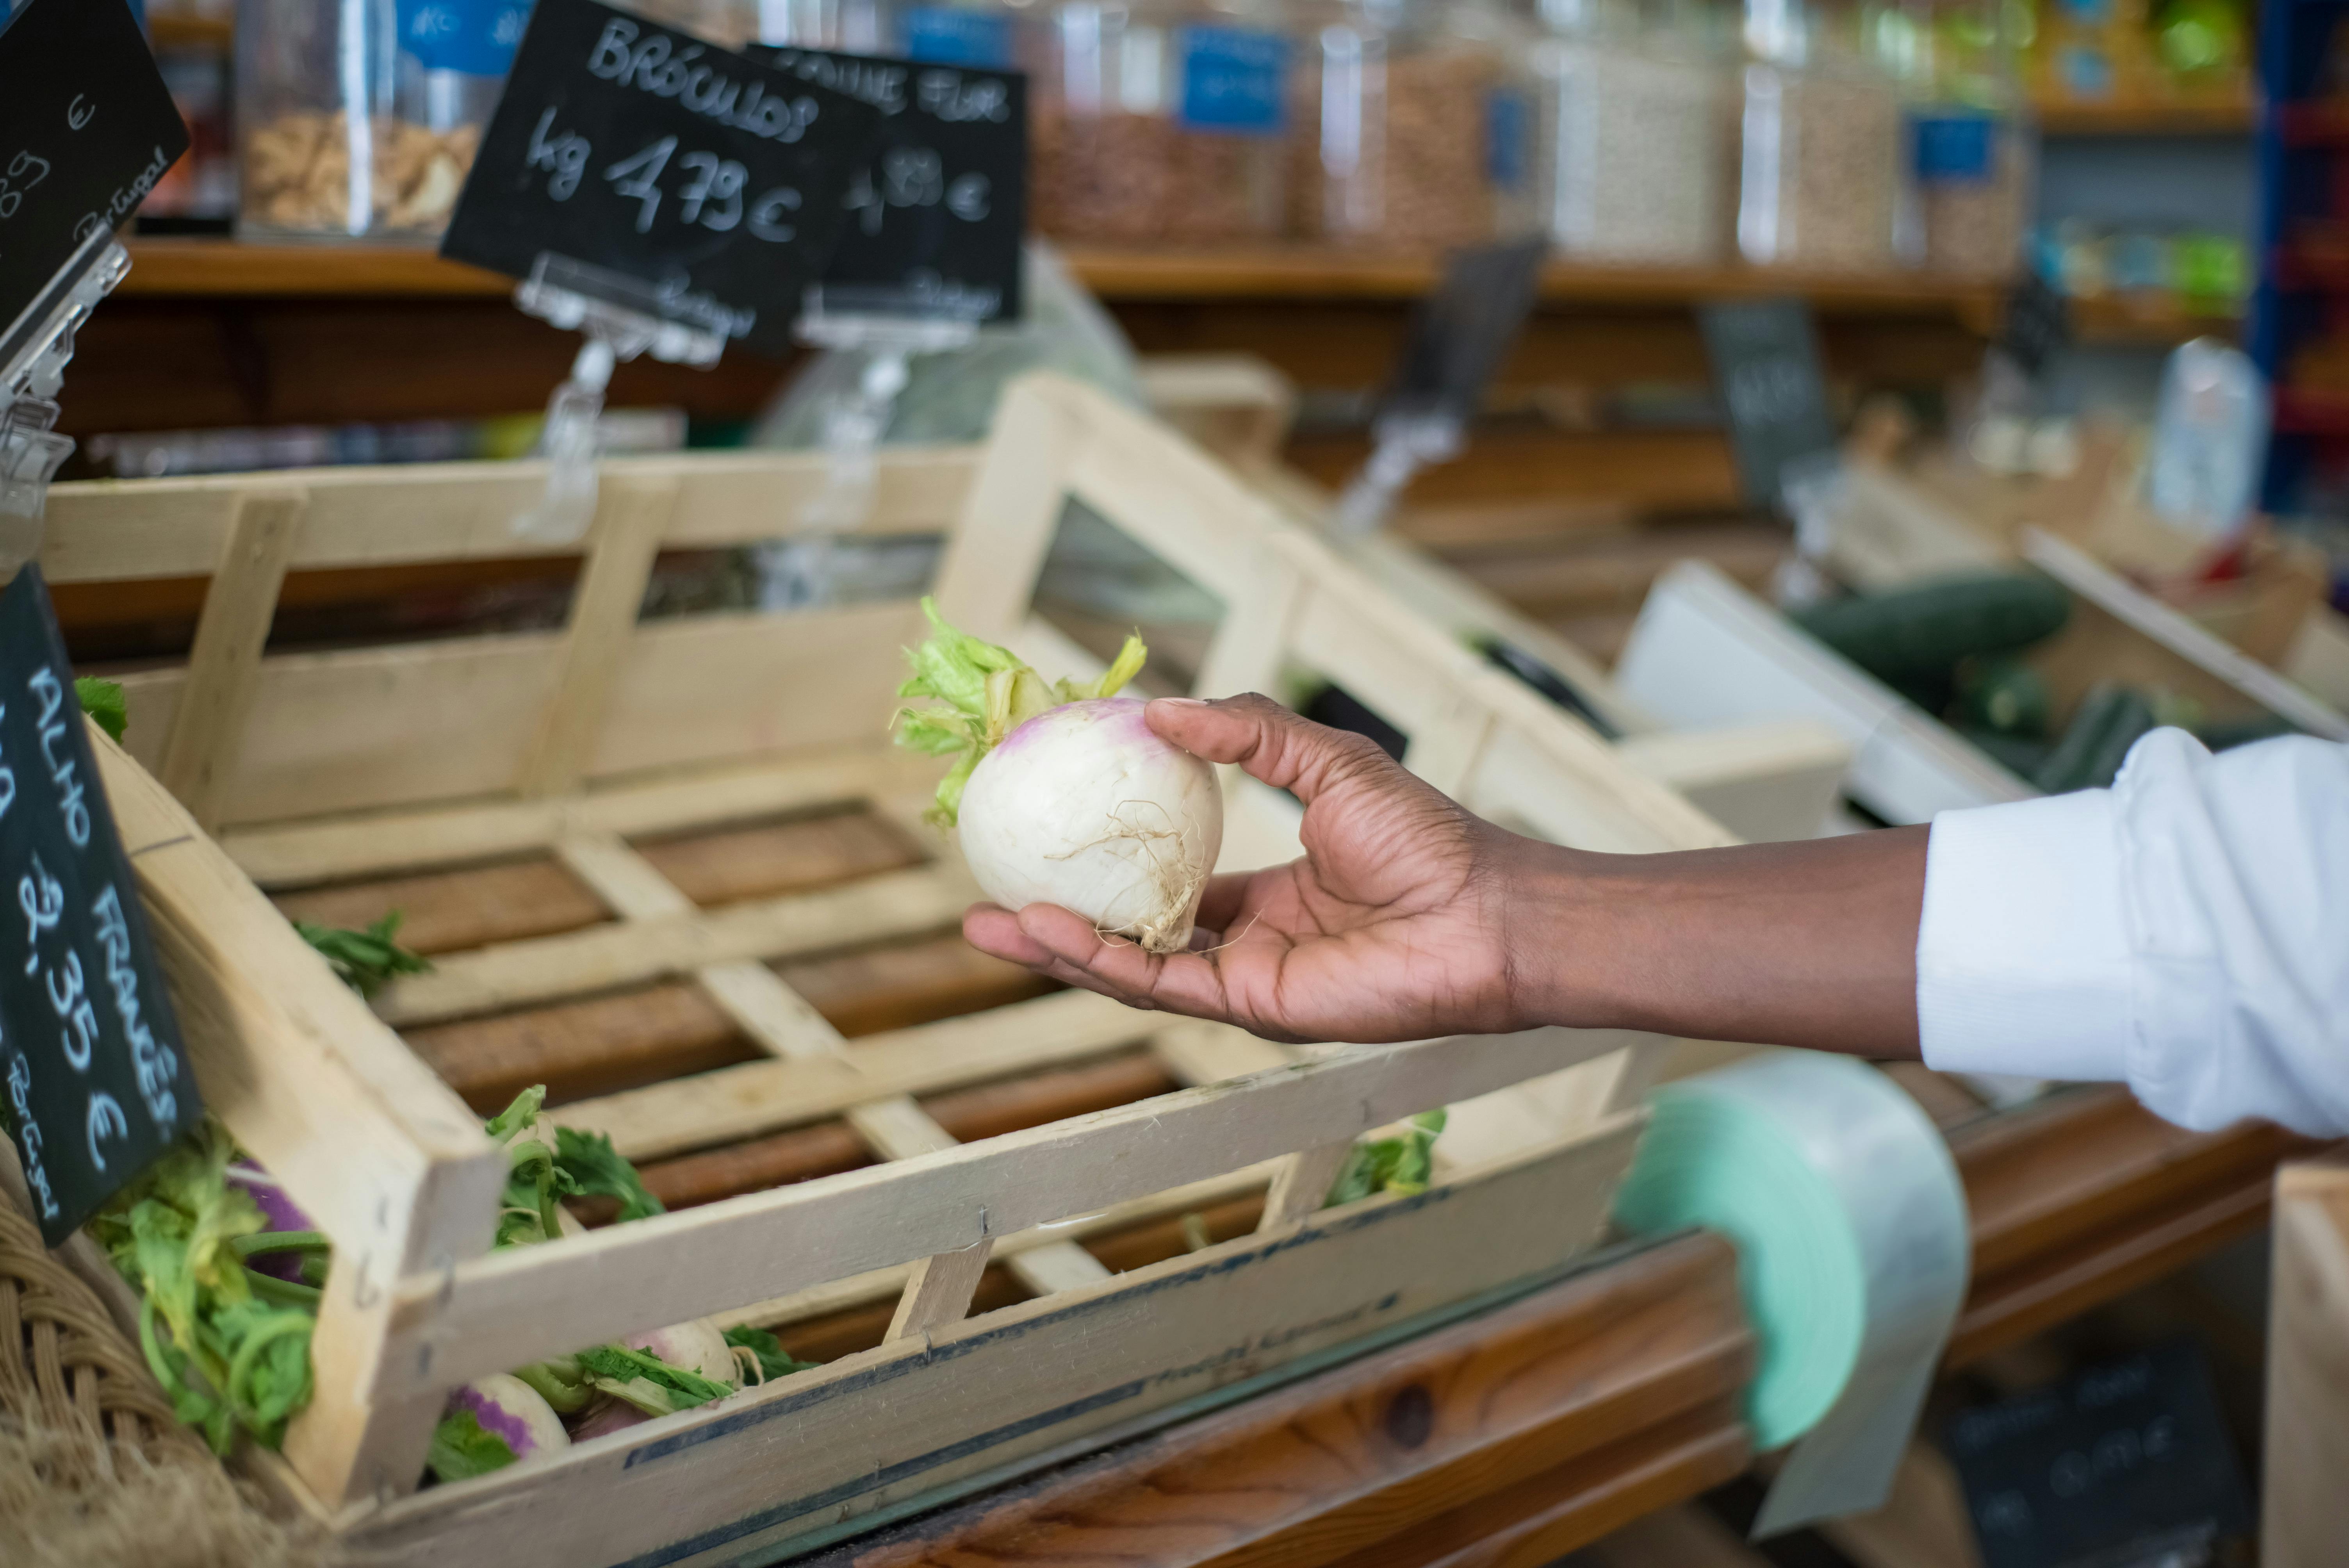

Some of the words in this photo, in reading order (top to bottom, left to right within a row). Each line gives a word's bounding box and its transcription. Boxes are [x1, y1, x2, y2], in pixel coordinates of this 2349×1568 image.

[68, 93, 95, 131] €
[73, 144, 169, 243] Prtugal
[526, 105, 591, 201] kg
[747, 185, 802, 243] €
[27, 666, 91, 848] ALHO
[86, 1090, 128, 1172] €
